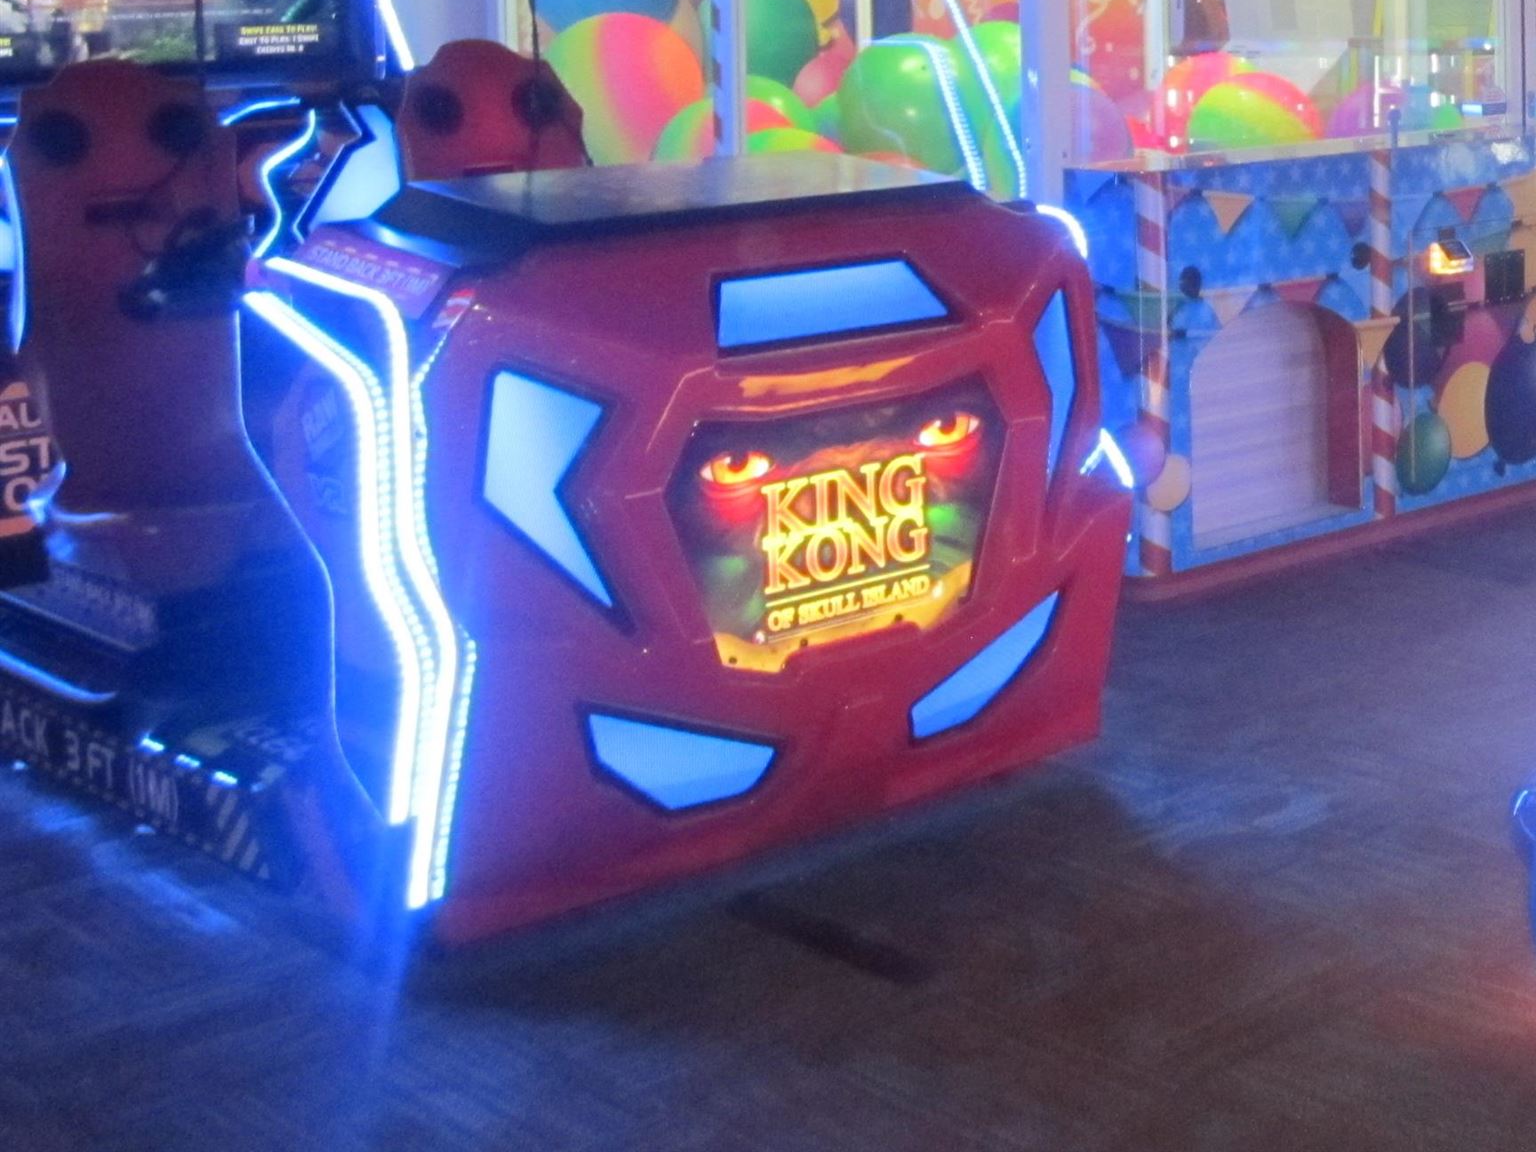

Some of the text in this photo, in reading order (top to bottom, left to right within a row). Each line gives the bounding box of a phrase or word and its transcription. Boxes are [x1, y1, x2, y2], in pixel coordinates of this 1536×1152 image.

[761, 453, 927, 538] KING
[762, 514, 930, 595] KONG
[767, 575, 930, 632] OF SKULL ISLAND
